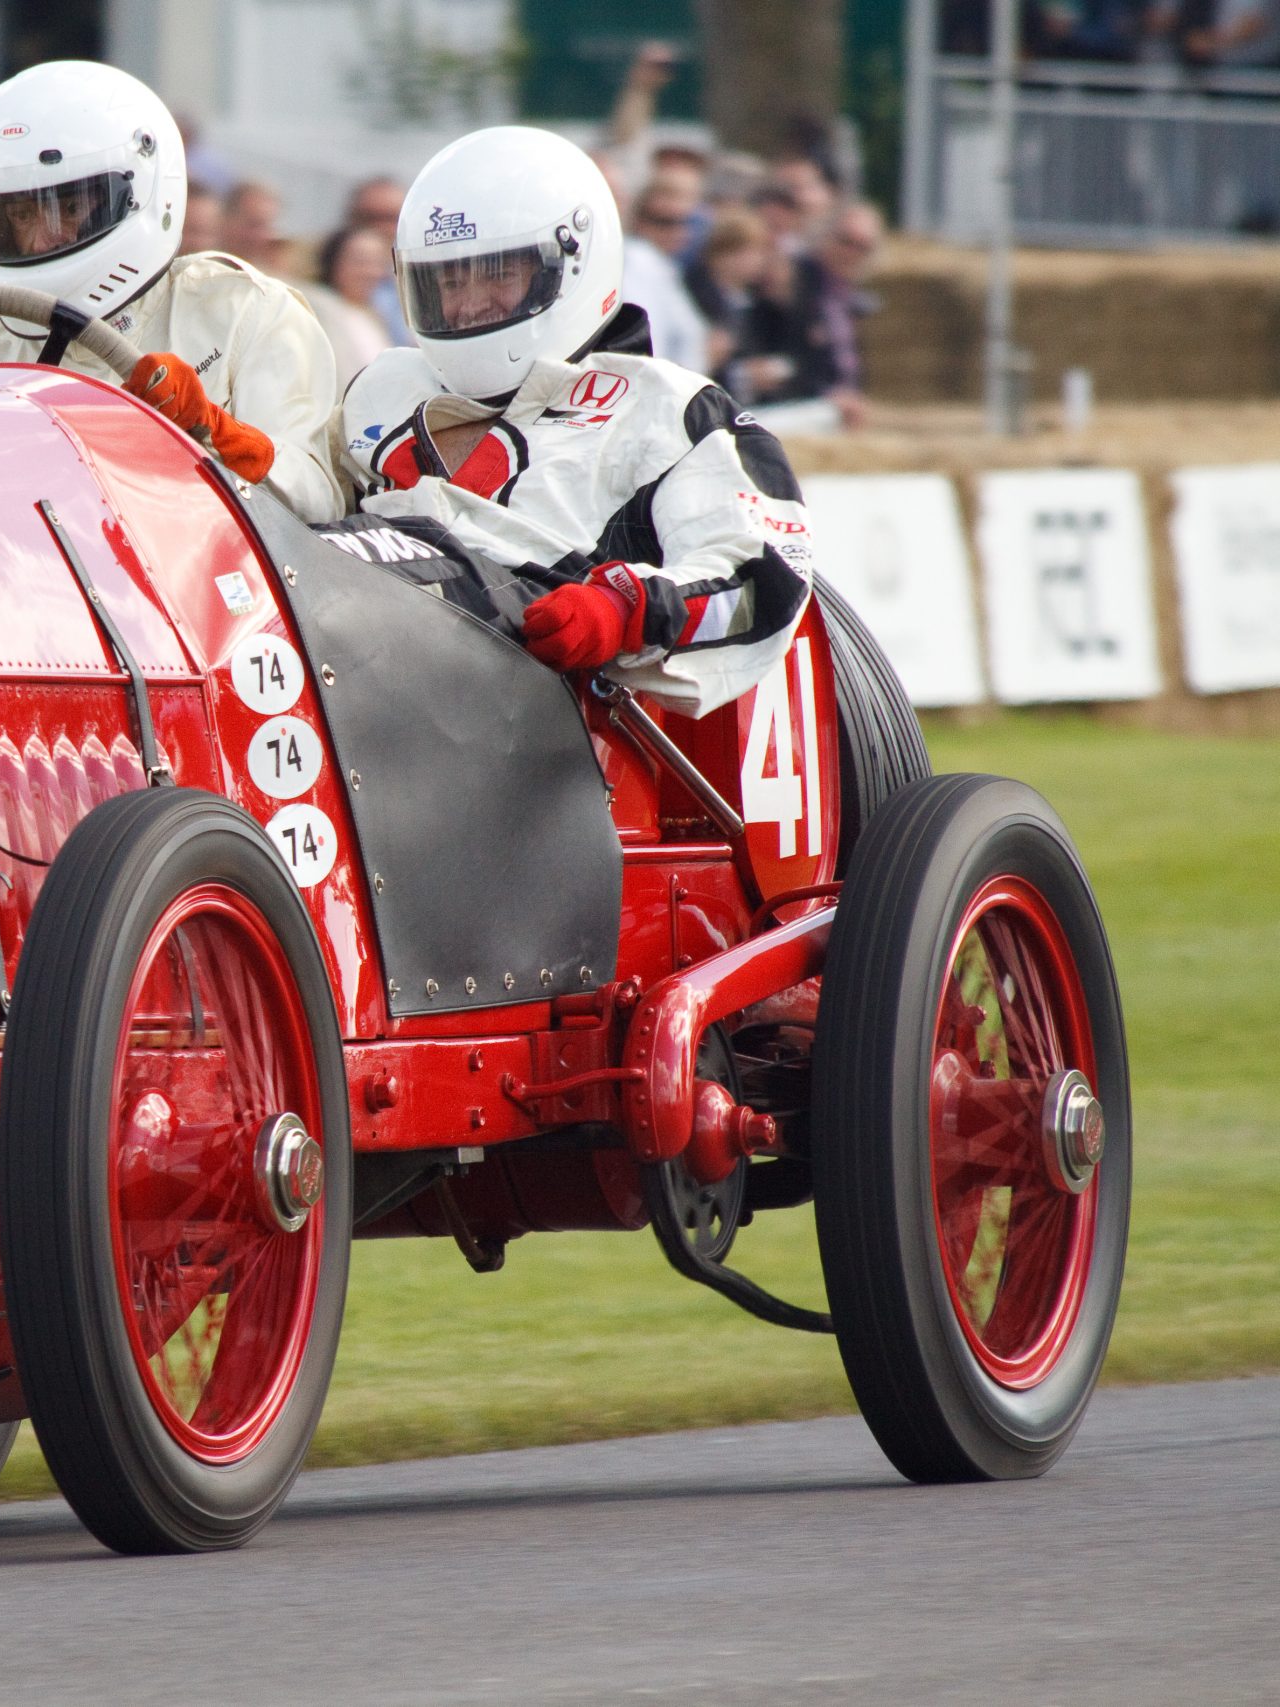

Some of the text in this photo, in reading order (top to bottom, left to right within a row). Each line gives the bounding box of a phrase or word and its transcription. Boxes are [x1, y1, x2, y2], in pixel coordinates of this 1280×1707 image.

[3, 126, 24, 136] BELL
[425, 225, 475, 246] sparco
[250, 651, 286, 695] 74
[266, 734, 303, 779] 74
[740, 636, 823, 860] 41
[282, 822, 319, 867] 74
